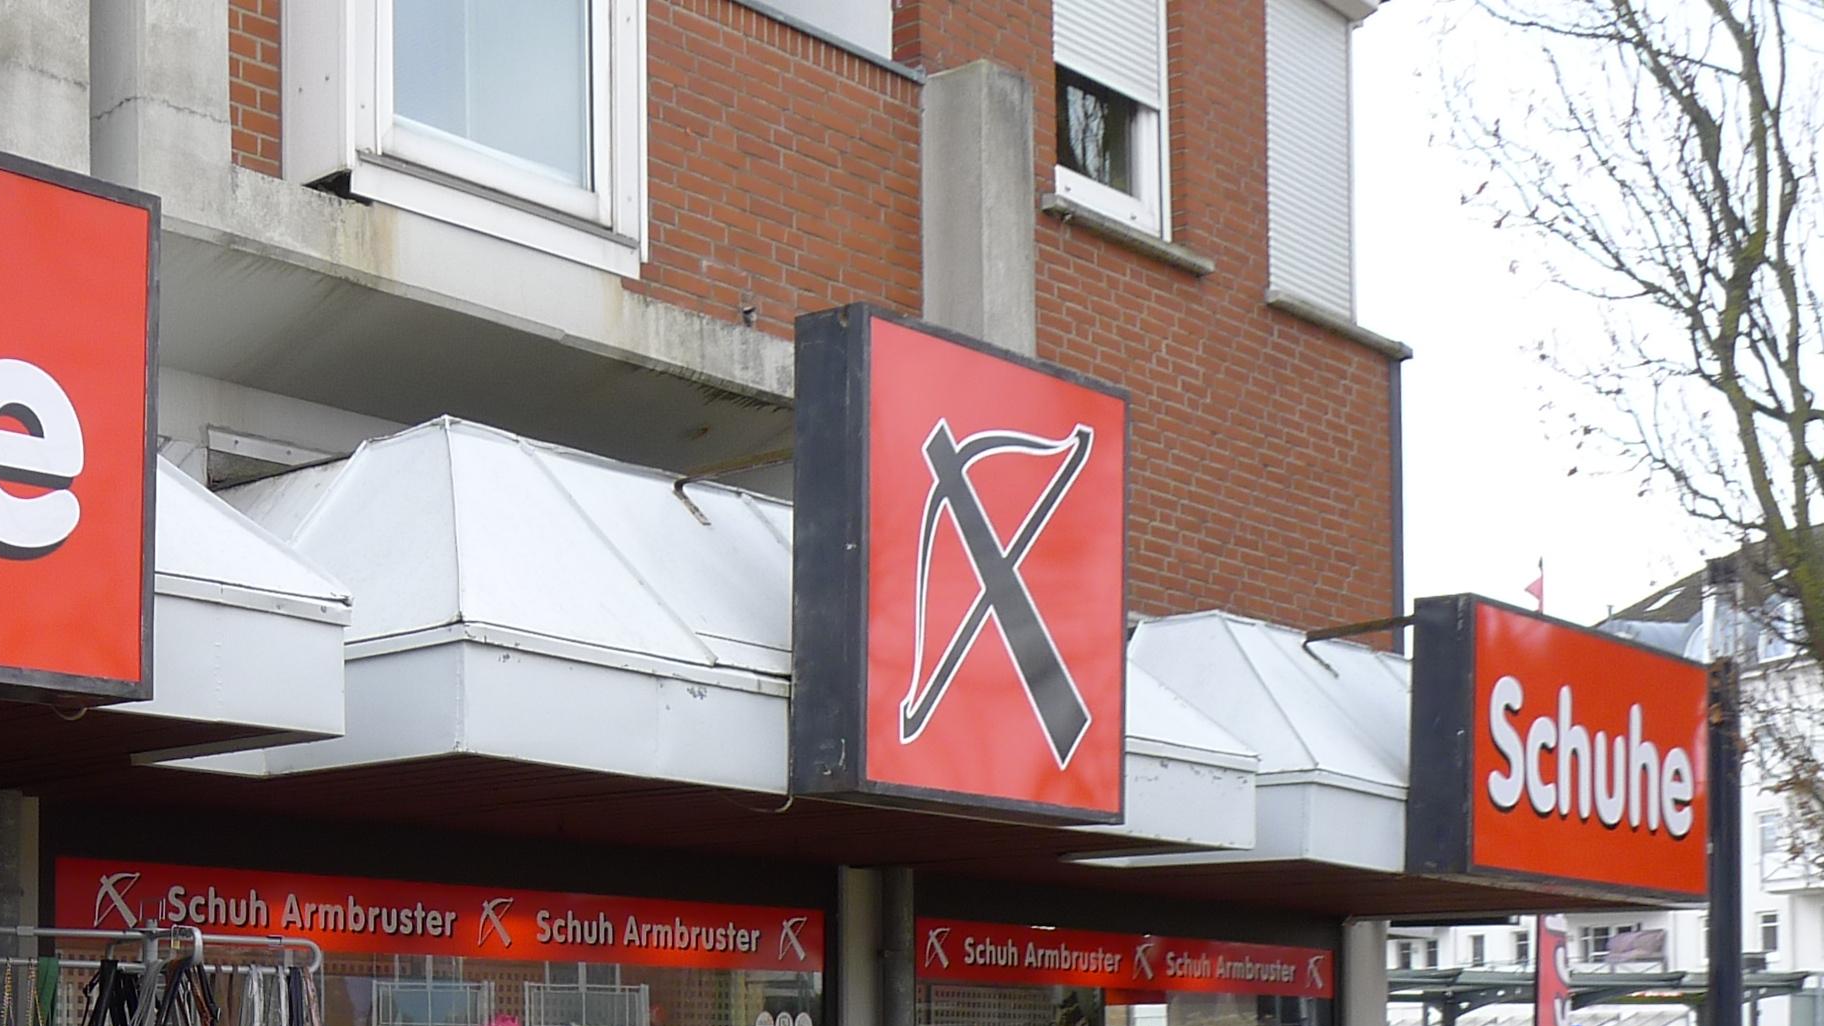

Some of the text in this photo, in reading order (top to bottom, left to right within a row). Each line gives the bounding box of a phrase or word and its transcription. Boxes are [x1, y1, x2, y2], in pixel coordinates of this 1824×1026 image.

[1487, 675, 1694, 840] Schuhe
[167, 885, 457, 936] Schuh Armbruster
[536, 909, 761, 952] Schuh Armbruster
[964, 936, 1123, 973] Schuh Armbruster
[1166, 951, 1296, 983] Schuh Armbruster
